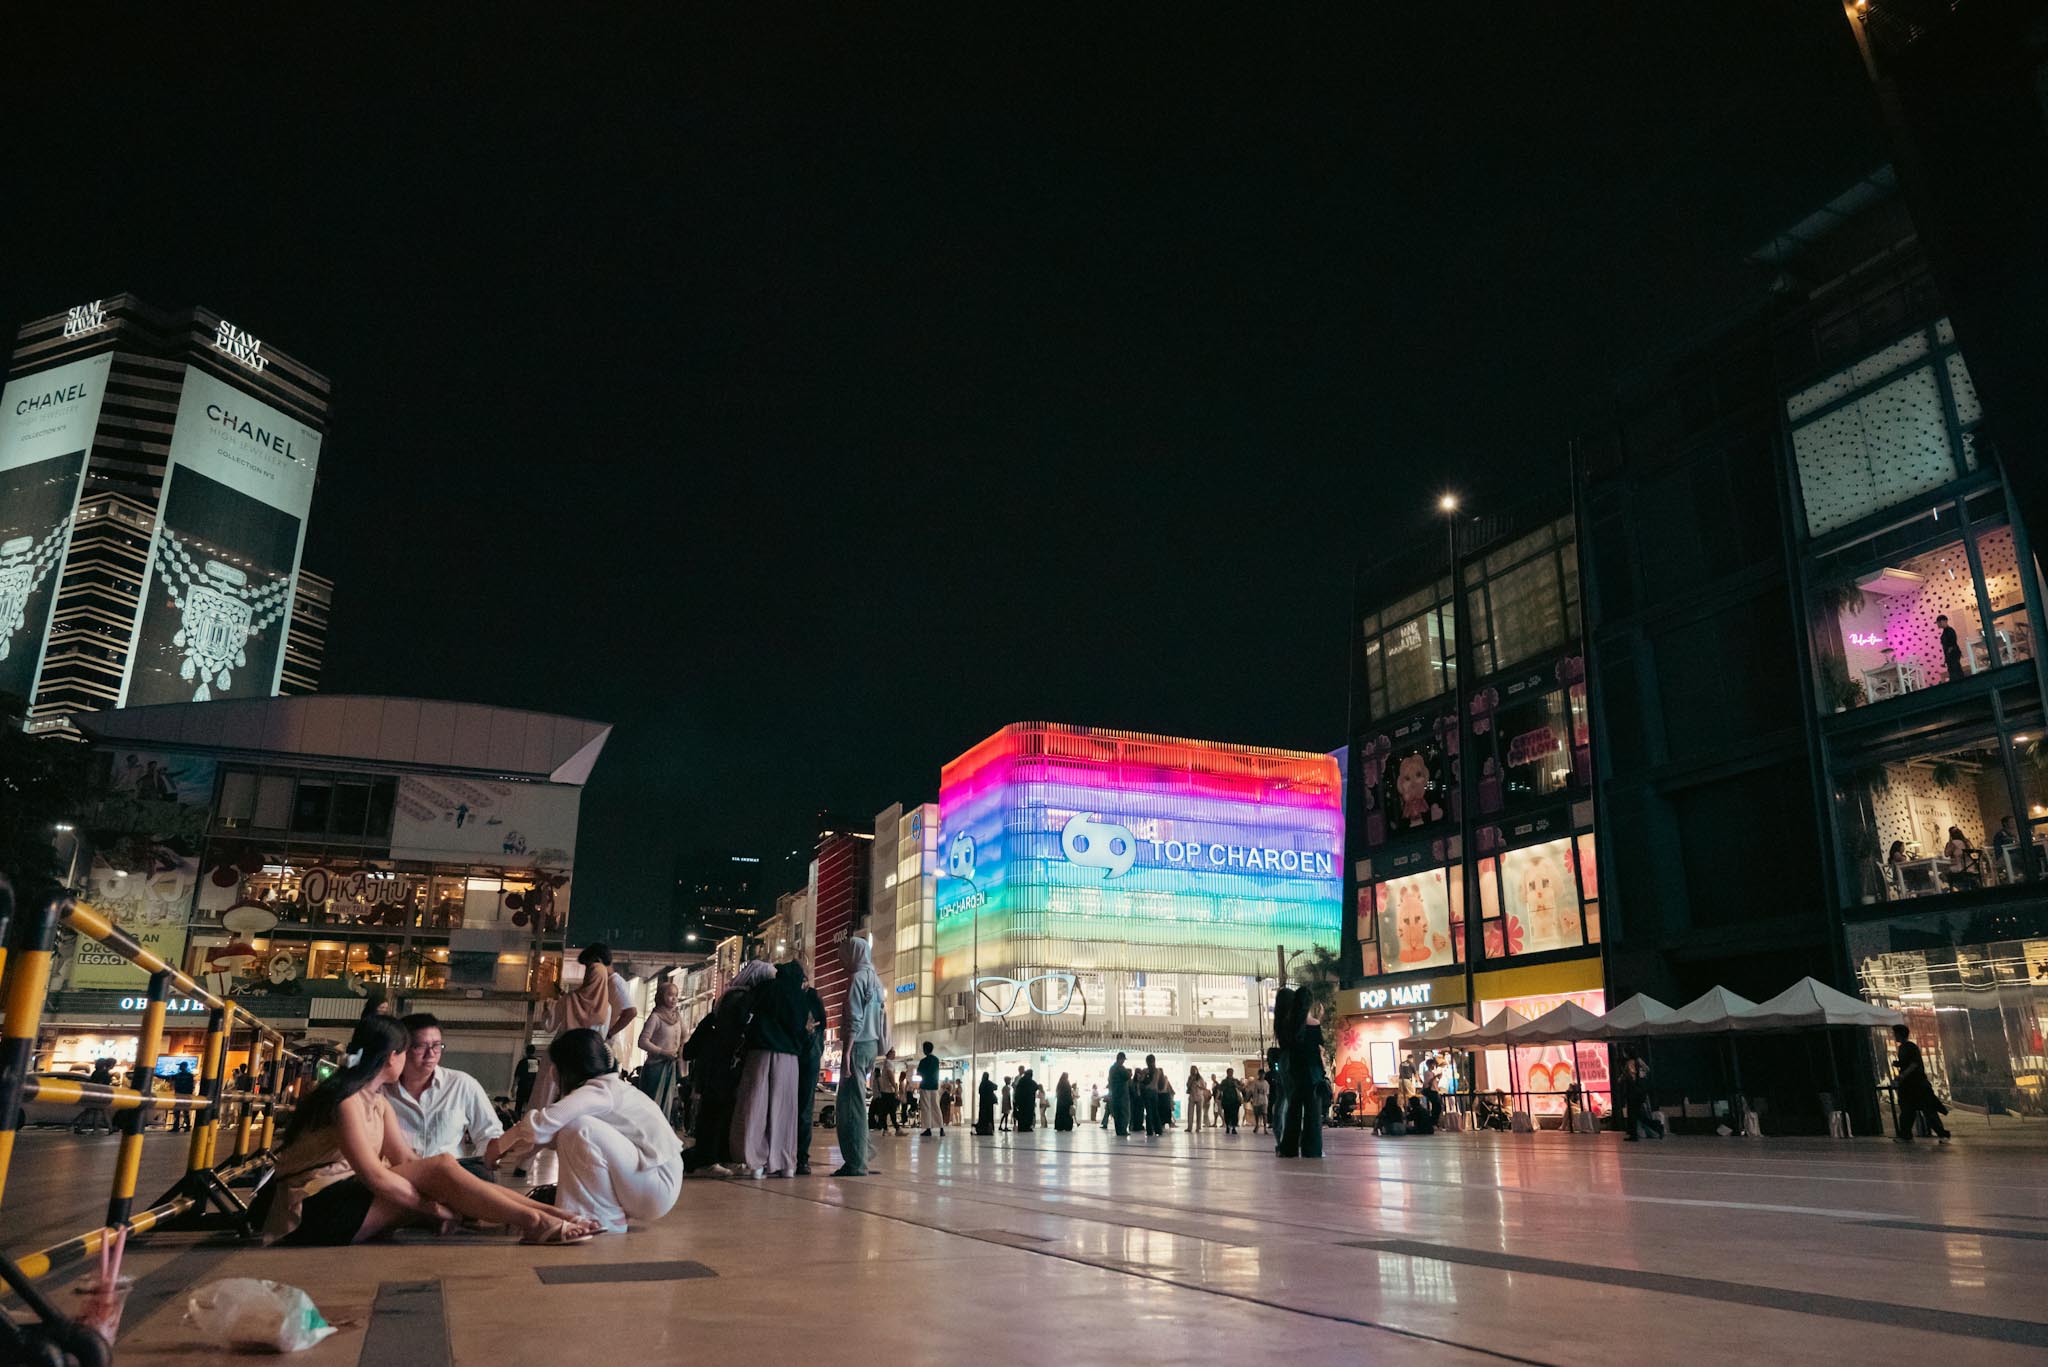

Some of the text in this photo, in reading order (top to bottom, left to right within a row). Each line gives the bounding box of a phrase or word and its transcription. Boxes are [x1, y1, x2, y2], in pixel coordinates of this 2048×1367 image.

[63, 311, 107, 337] PIWAT
[68, 300, 102, 321] SIAM
[214, 333, 269, 372] PIWAT
[219, 320, 261, 354] SIAM
[16, 383, 87, 415] CHANEL
[207, 405, 296, 460] CHANEL
[1150, 840, 1332, 874] TOP CHAROEN
[301, 869, 407, 905] OHKAJHU
[142, 934, 160, 943] AN
[1359, 984, 1431, 1010] POP MART
